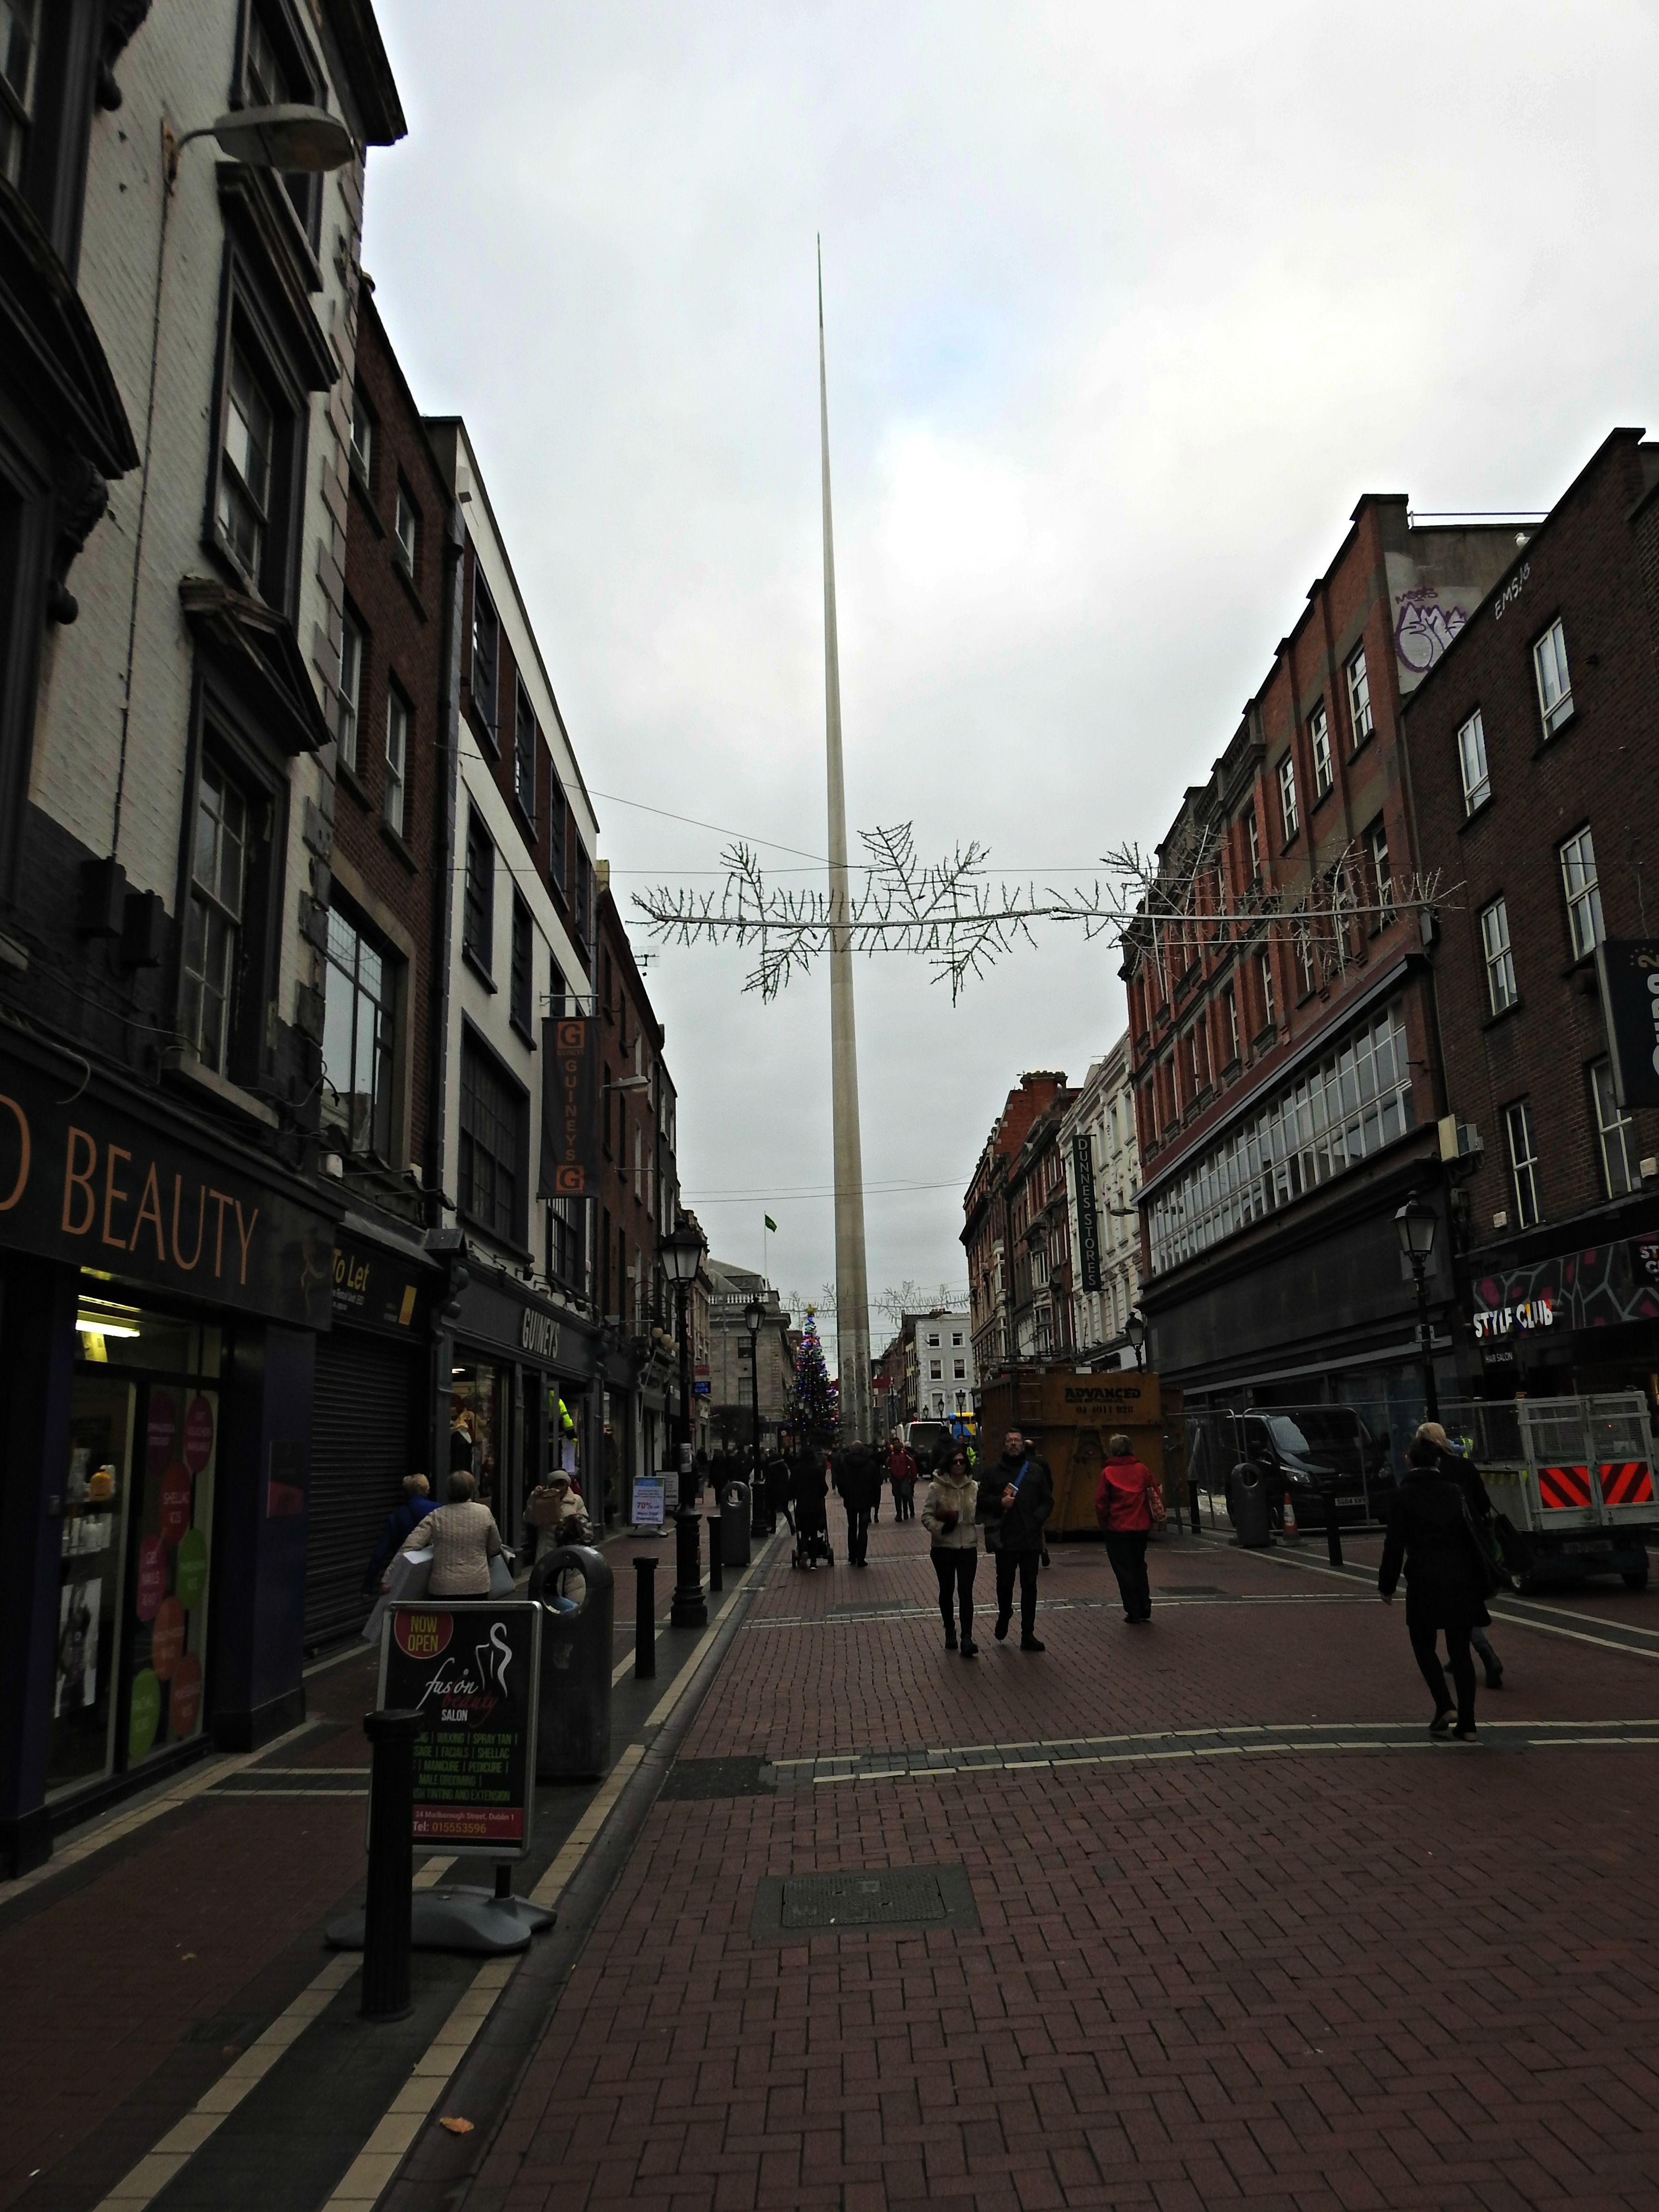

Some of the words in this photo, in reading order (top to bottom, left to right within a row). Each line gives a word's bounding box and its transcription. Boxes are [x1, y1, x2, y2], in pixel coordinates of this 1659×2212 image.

[561, 1023, 581, 1046] G
[565, 1059, 577, 1161] GUINEYS
[559, 1167, 580, 1190] G
[1078, 1138, 1091, 1209] DUNNES
[61, 1125, 259, 1286] BEAUTY
[1084, 1213, 1096, 1286] STORES
[333, 1248, 346, 1284] To
[347, 1255, 370, 1292] Let
[1473, 1307, 1513, 1338] STYLE
[1516, 1299, 1553, 1329] CLUB
[522, 1307, 560, 1358] GUINEYS
[1485, 1354, 1496, 1363] HAIR
[1496, 1351, 1513, 1362] SALON
[1065, 1388, 1141, 1398] ADVANCED
[410, 1615, 437, 1633] NOW
[408, 1635, 439, 1652] OPEN
[415, 1657, 479, 1710] fusion
[441, 1689, 499, 1728] beauty
[441, 1708, 469, 1722] SALON
[436, 1732, 465, 1744] WAXING
[473, 1733, 496, 1744] SPRAY
[497, 1733, 512, 1745] TAN
[441, 1746, 469, 1758] FACIALS
[477, 1747, 510, 1759] SHELLAC
[423, 1760, 460, 1771] MANICURE
[468, 1761, 503, 1773] PEDICURE
[418, 1774, 438, 1785] MALE
[440, 1775, 477, 1786] GROOMING
[427, 1788, 454, 1800] TINTING
[455, 1789, 470, 1800] AND
[471, 1790, 511, 1802] EXTENSION
[425, 1811, 465, 1821] Marlborough
[413, 1821, 429, 1832] Tel:
[432, 1822, 487, 1834] 015553596
